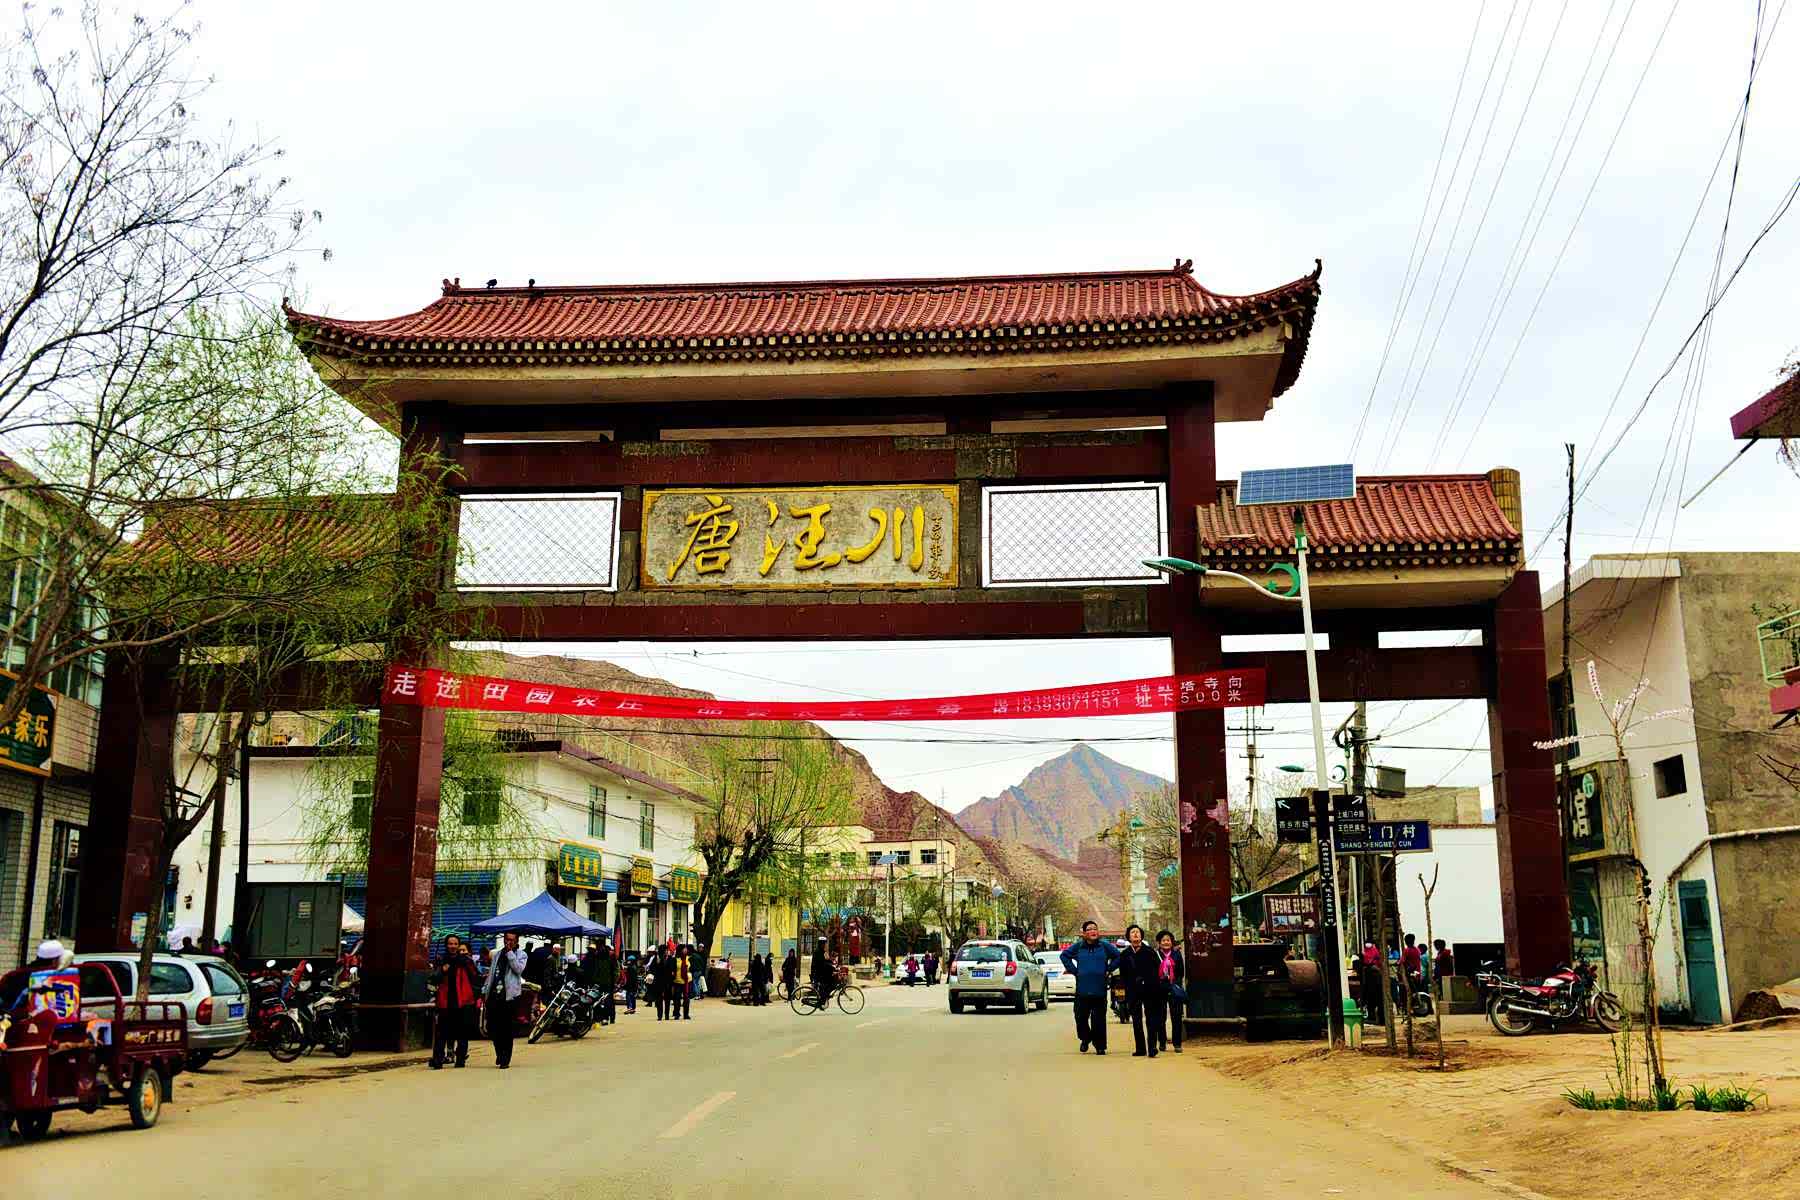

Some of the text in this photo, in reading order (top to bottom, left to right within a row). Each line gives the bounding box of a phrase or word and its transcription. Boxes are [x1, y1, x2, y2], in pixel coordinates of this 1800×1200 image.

[667, 495, 925, 581] 唐汪川
[1368, 825, 1416, 839] 门村
